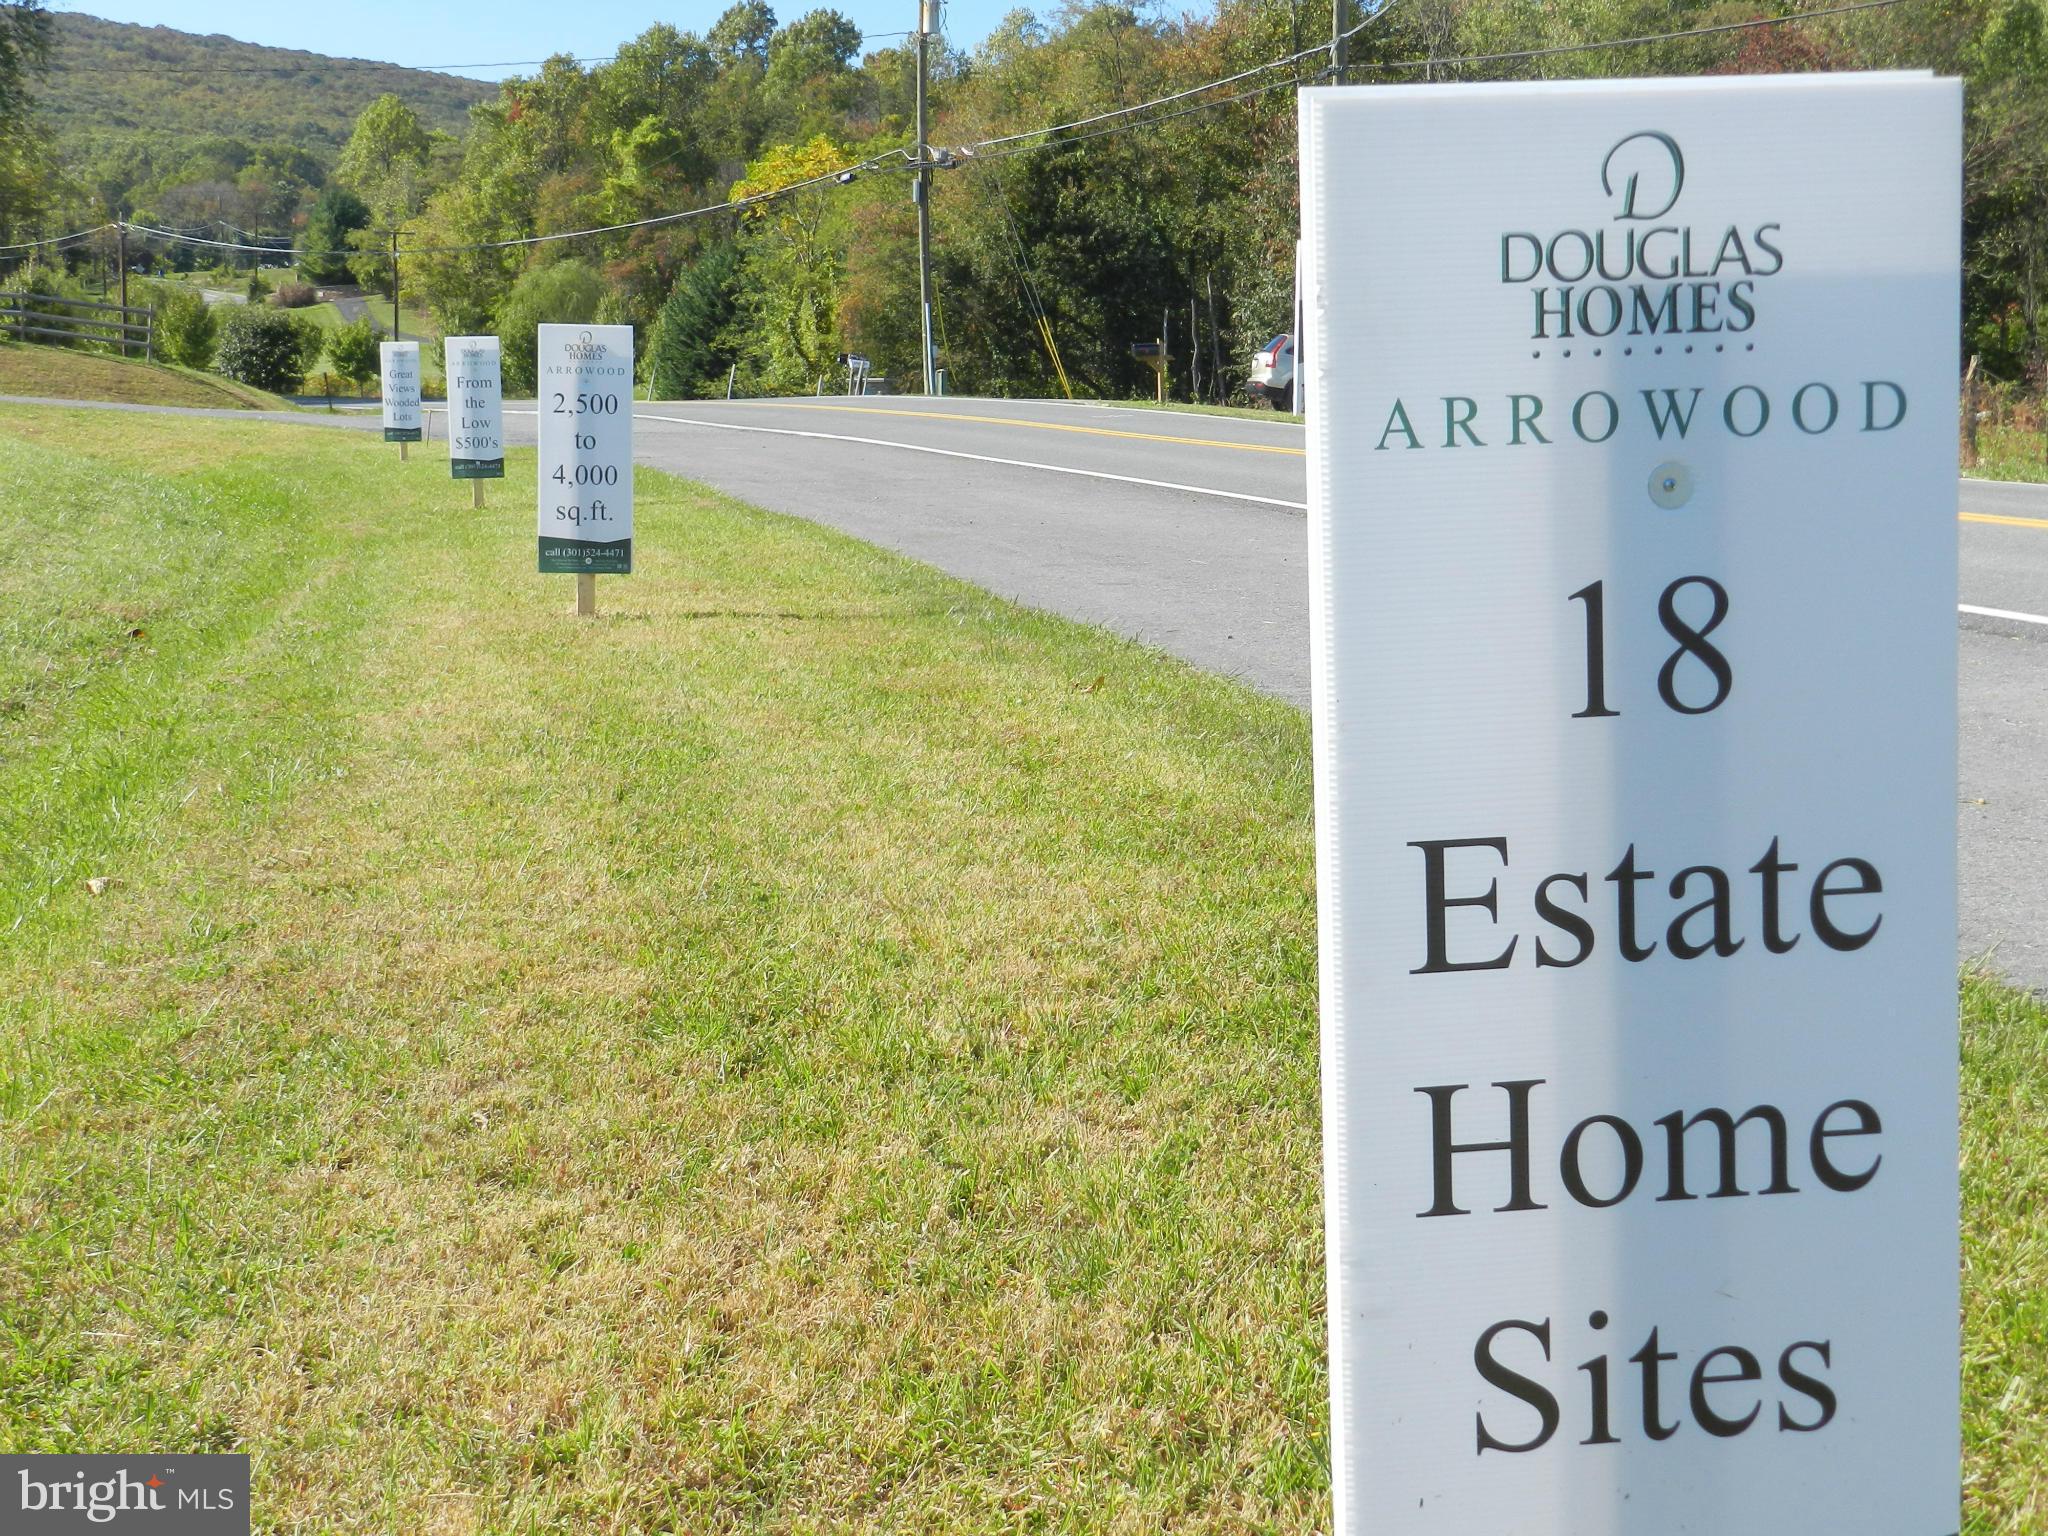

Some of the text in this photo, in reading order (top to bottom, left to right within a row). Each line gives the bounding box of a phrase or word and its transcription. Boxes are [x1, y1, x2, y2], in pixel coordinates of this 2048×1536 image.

[1501, 223, 1784, 284] DOUGLAS
[1530, 280, 1757, 339] HOMES
[564, 343, 607, 353] DOUGLAS
[569, 352, 603, 360] HOMES
[389, 369, 414, 379] Great
[546, 366, 626, 376] ARROWOOD
[388, 383, 416, 393] Views
[457, 376, 493, 388] From
[384, 397, 420, 407] Wooded
[465, 396, 486, 409] the
[552, 392, 618, 418] 2,500
[393, 412, 412, 421] Lots
[1374, 380, 1908, 451] ARROWOOD
[461, 416, 492, 429] Low
[575, 431, 597, 450] to
[552, 464, 618, 488] 4,000
[545, 547, 561, 557] call
[1567, 575, 1734, 719] 18
[1406, 835, 1883, 975] Estate
[1413, 1078, 1882, 1219] Home
[1474, 1310, 1837, 1457] Sites
